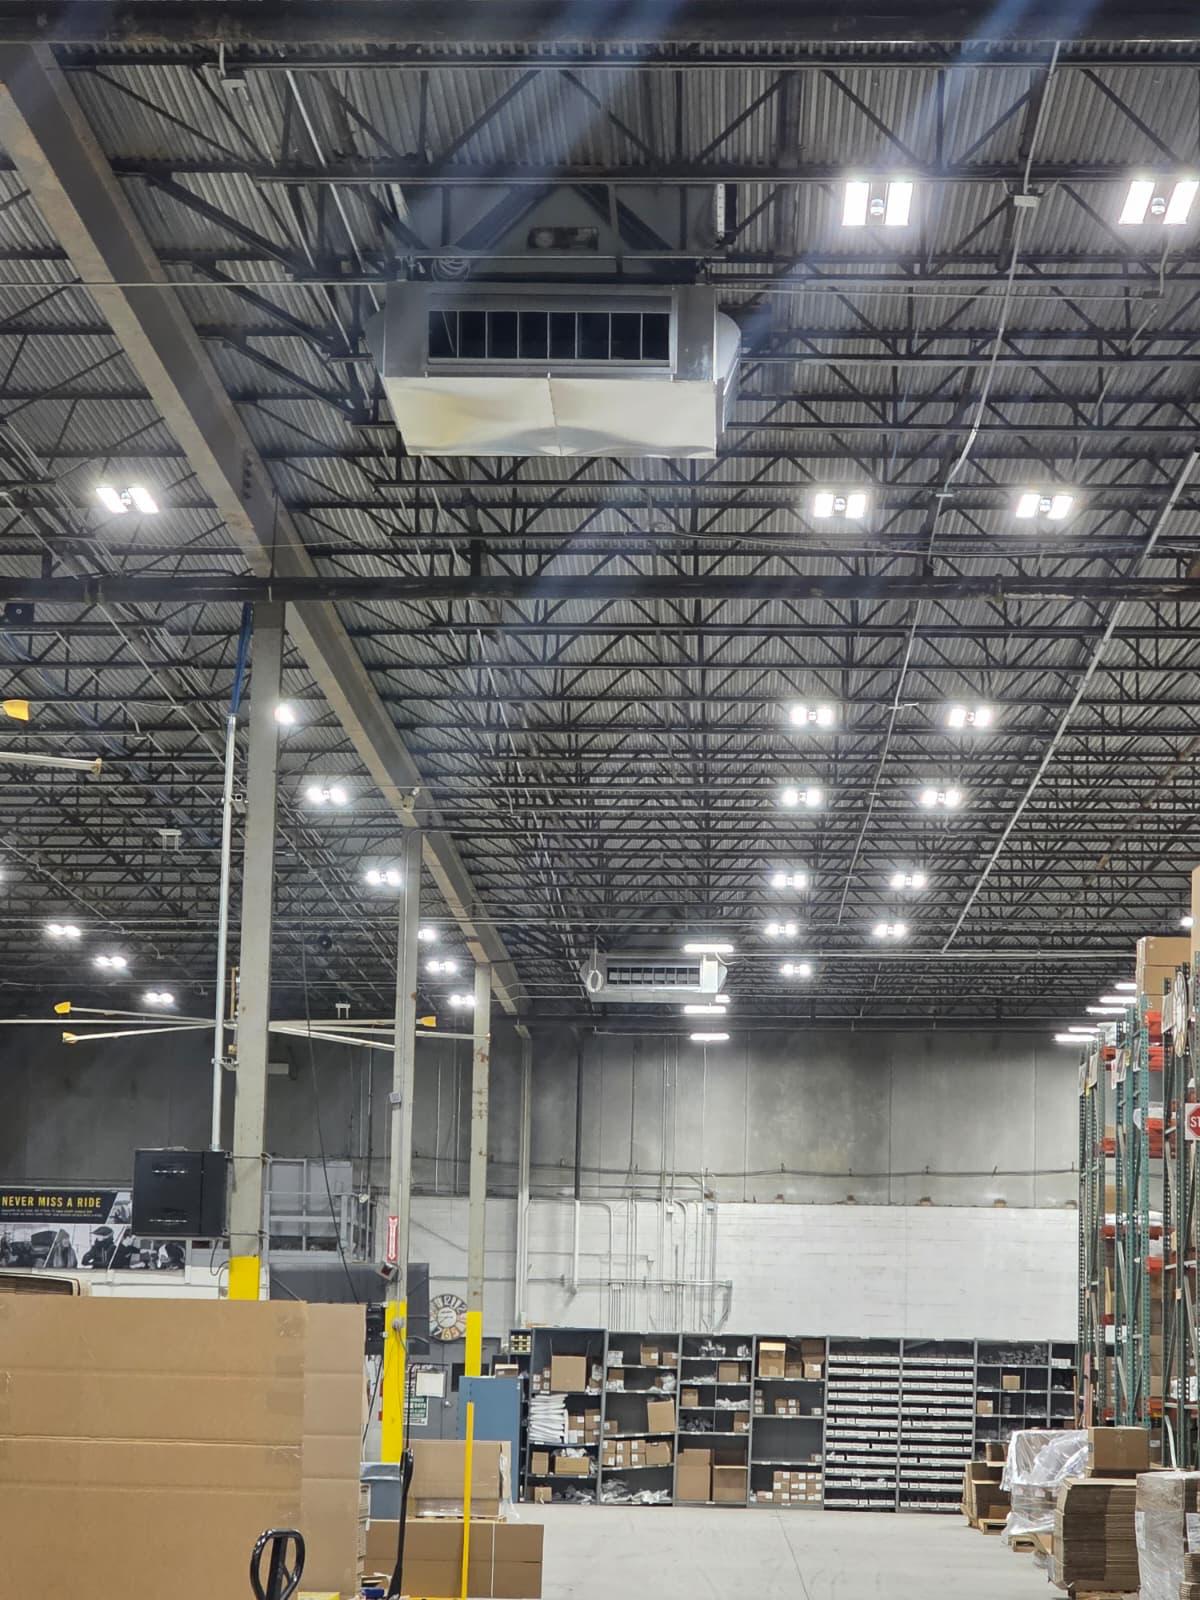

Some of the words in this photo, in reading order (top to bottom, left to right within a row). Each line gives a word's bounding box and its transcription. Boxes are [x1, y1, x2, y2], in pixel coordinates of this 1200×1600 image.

[1, 1196, 34, 1206] NEVER
[38, 1196, 63, 1207] MISS
[66, 1197, 73, 1207] A
[77, 1197, 101, 1208] RIDE
